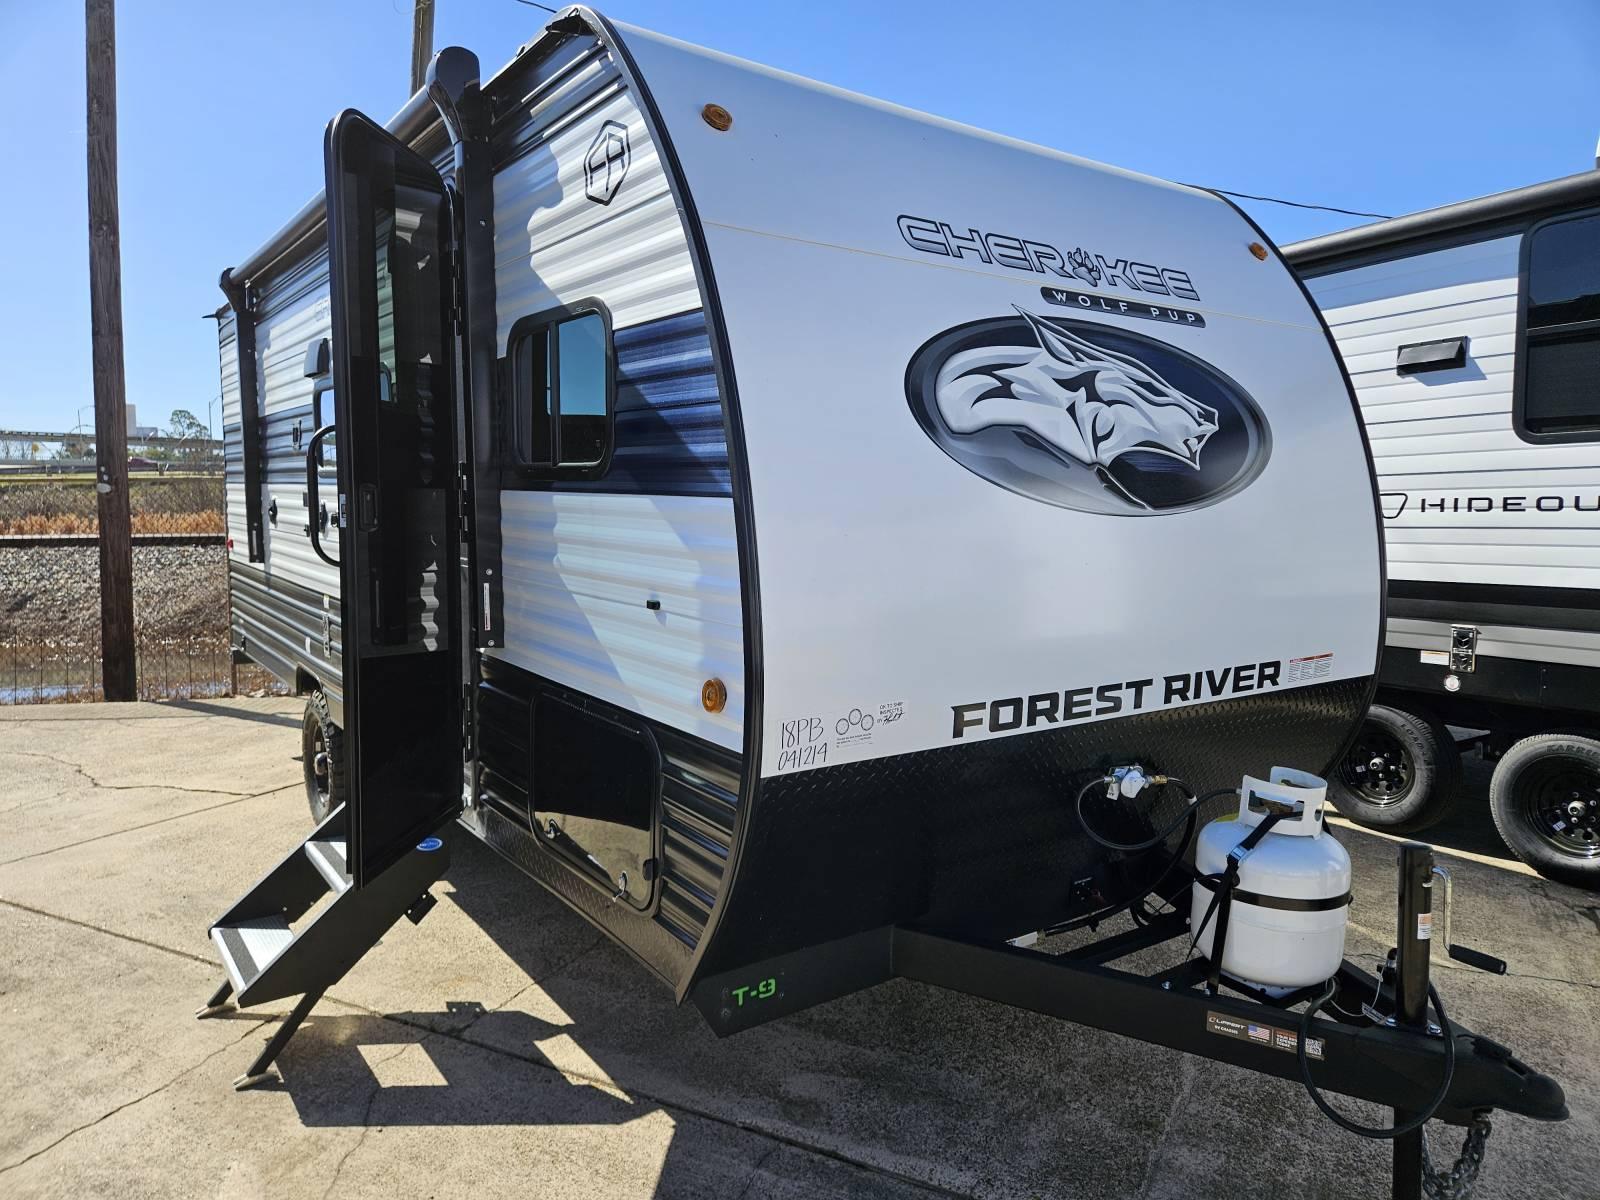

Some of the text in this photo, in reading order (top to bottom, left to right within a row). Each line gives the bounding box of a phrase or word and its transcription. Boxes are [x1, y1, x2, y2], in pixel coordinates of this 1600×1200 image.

[1052, 290, 1196, 323] WOLF PUP
[1420, 495, 1600, 513] HIDEOU
[951, 678, 1154, 738] FOREST
[1162, 660, 1282, 705] RIVER
[781, 717, 824, 750] 18PB
[732, 978, 776, 1006] T-9
